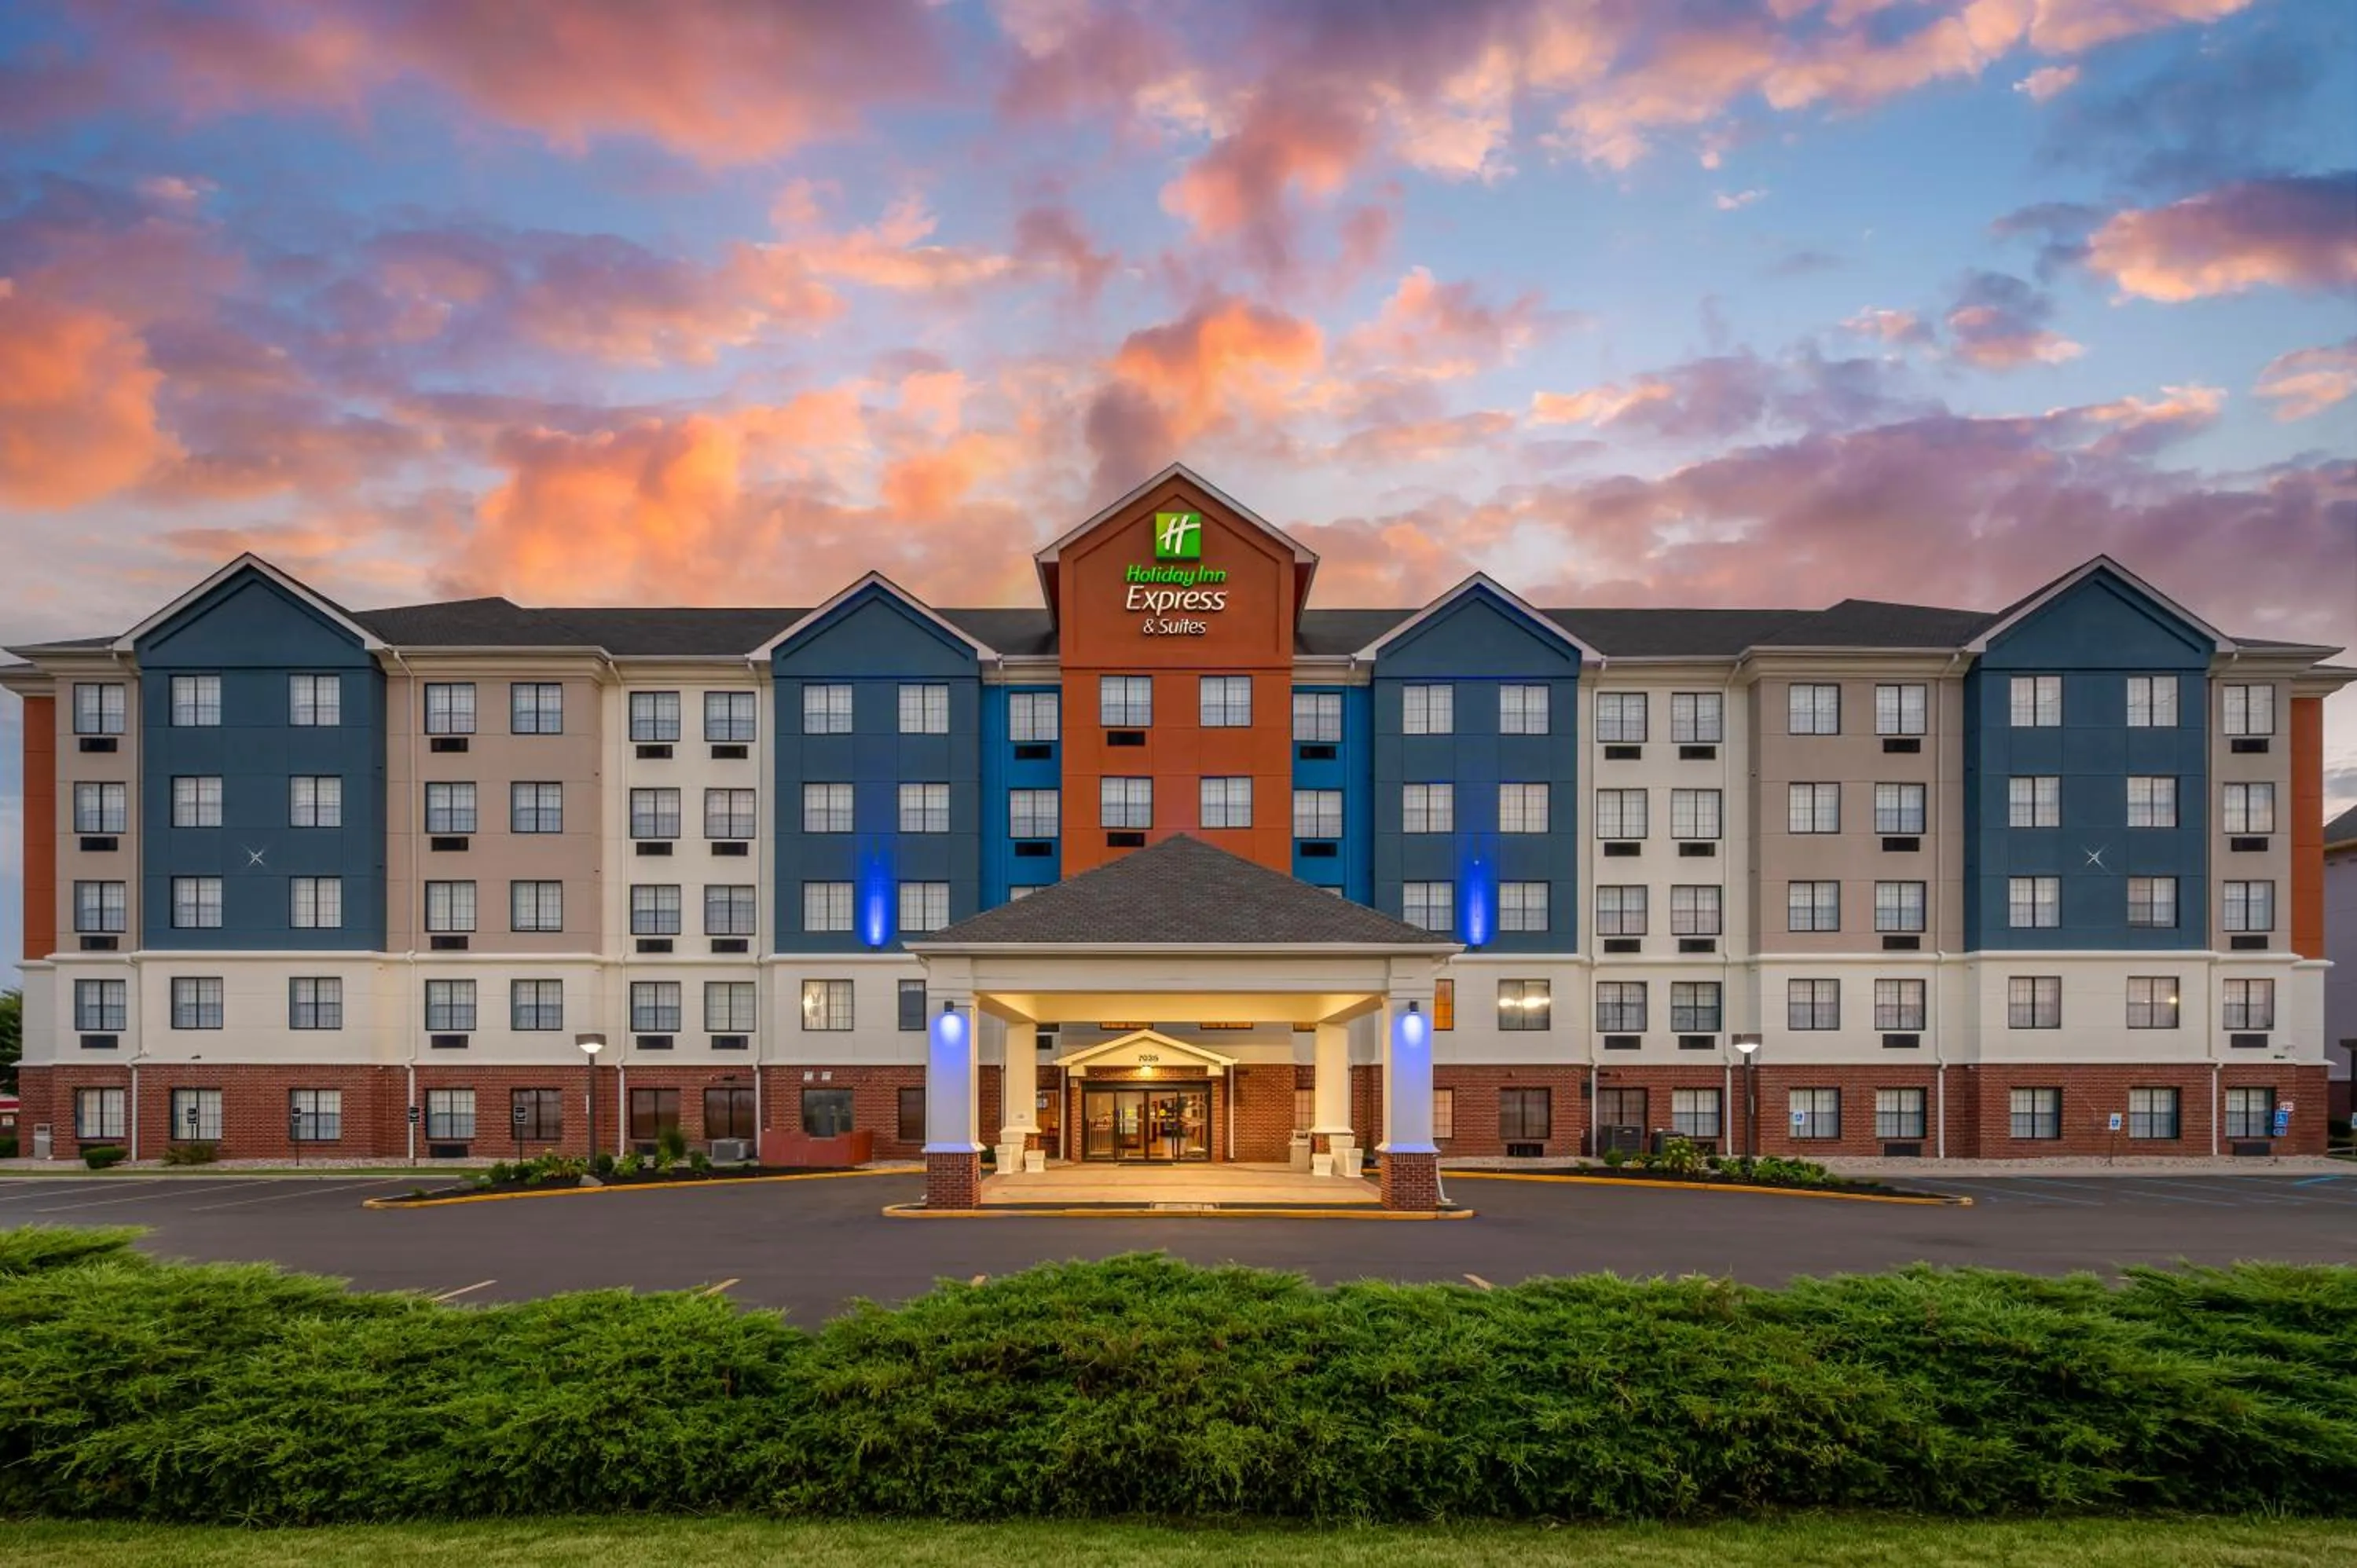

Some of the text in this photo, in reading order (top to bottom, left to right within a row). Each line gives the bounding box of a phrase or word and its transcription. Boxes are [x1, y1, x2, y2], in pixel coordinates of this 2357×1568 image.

[1159, 515, 1200, 554] H
[1126, 565, 1226, 586] Holiday Inn
[1126, 585, 1227, 616] Express
[1143, 618, 1207, 634] & Suites
